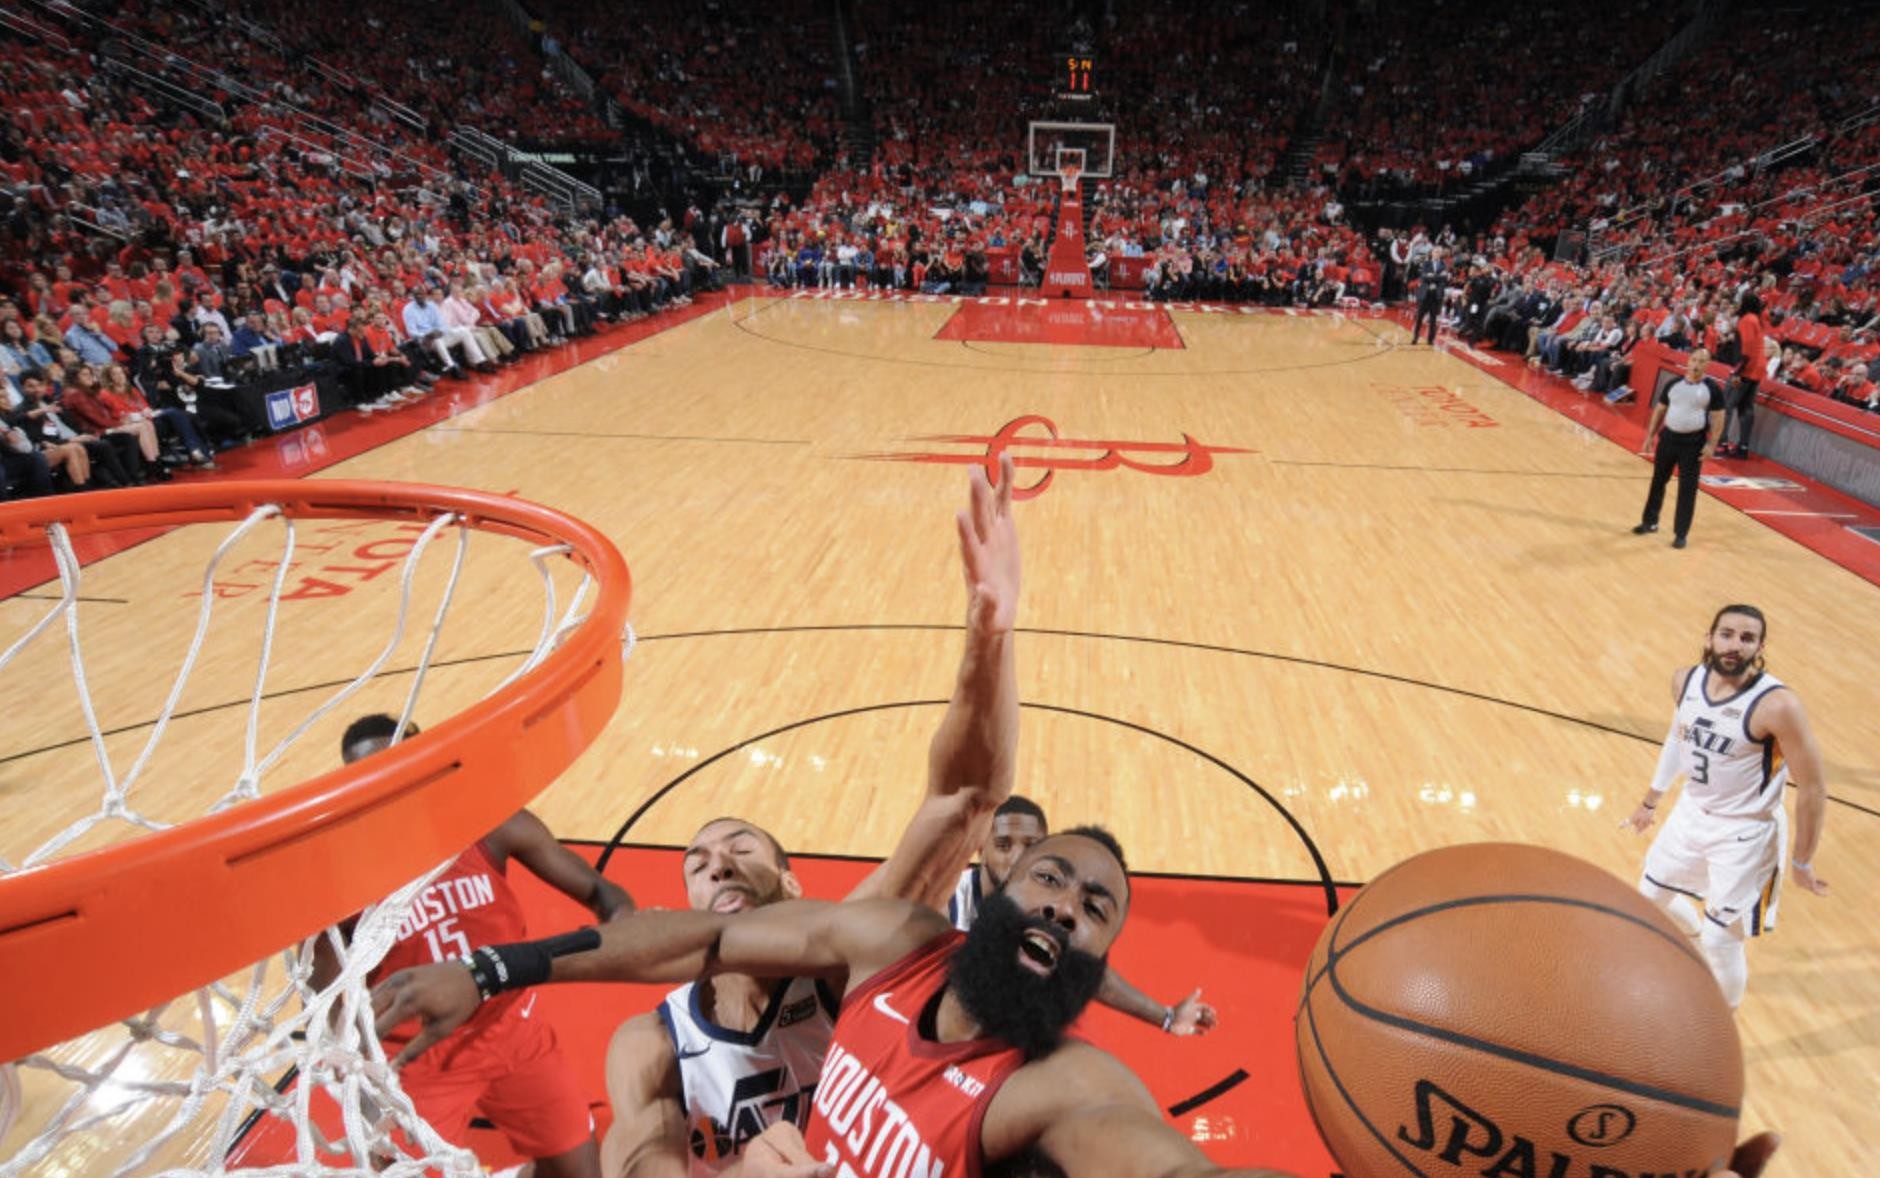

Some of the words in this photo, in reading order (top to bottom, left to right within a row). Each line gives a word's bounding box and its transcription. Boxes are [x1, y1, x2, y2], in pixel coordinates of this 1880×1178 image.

[1691, 750, 1709, 785] 3
[397, 874, 495, 941] OUSTON
[424, 917, 472, 963] 15
